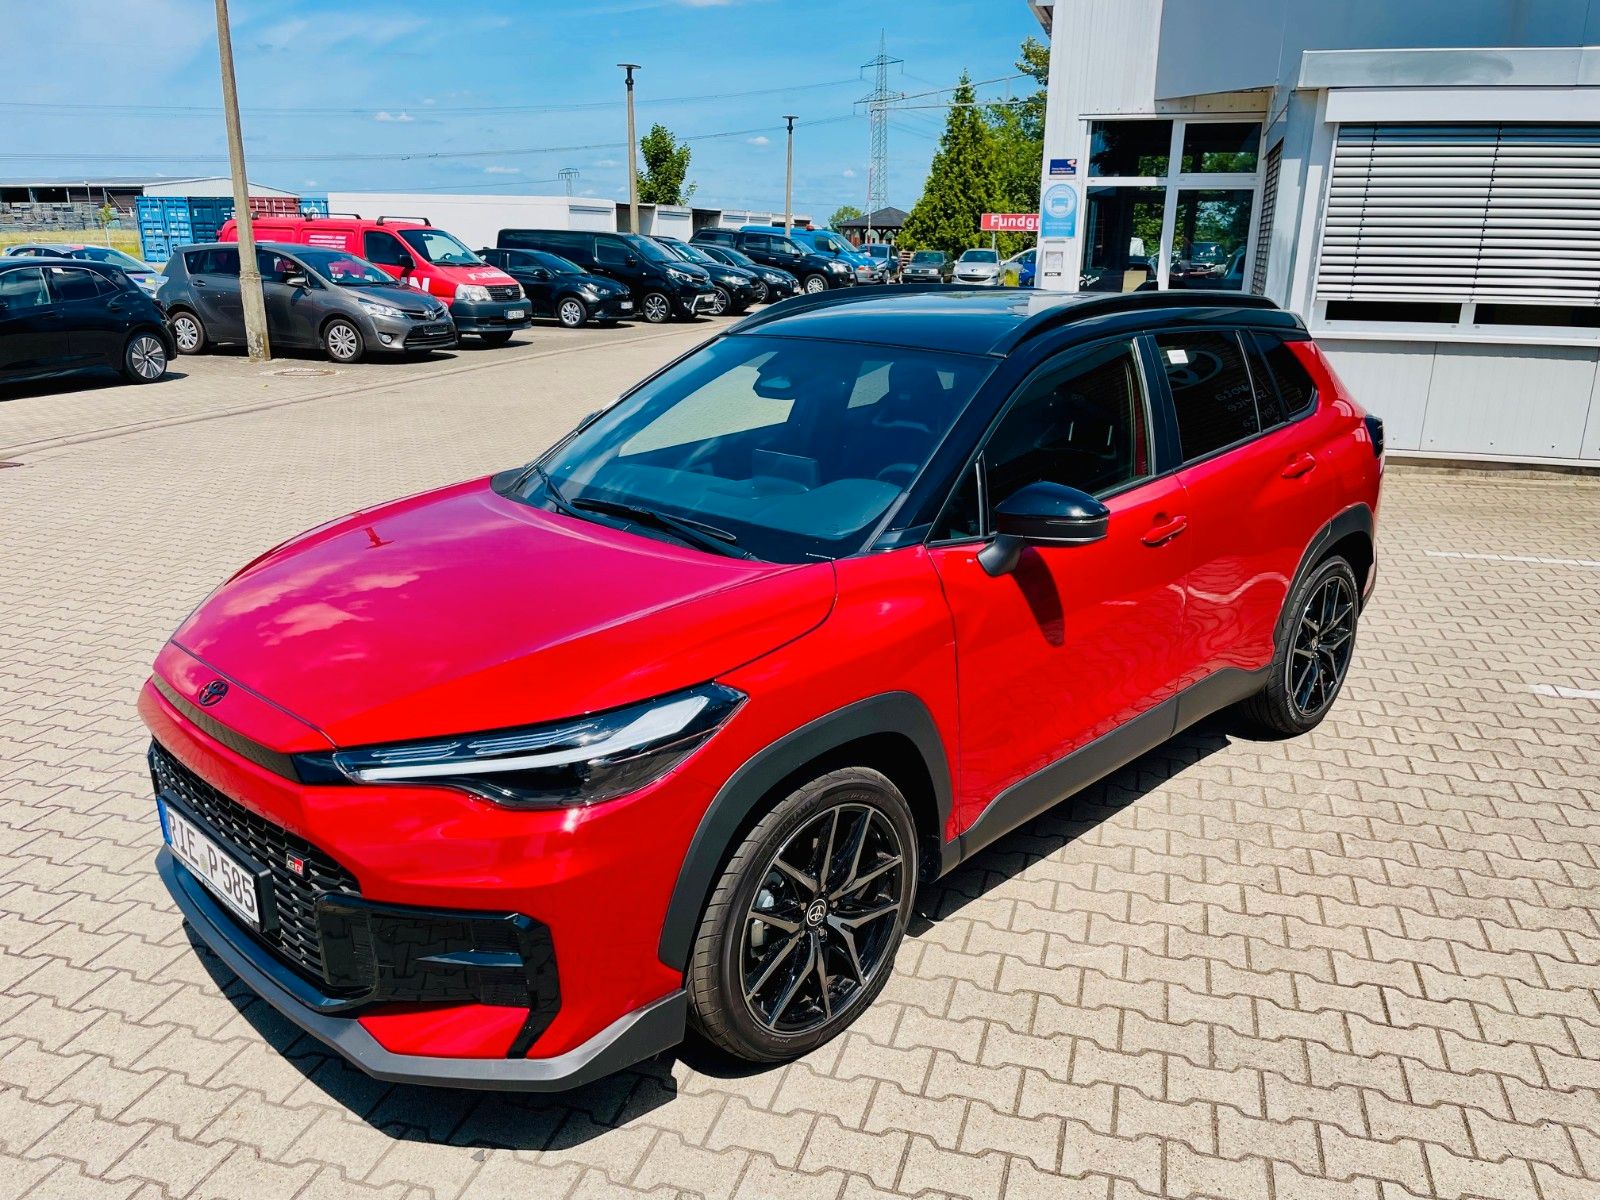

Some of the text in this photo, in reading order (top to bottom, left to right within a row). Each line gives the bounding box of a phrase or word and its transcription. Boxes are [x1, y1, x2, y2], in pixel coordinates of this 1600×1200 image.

[168, 812, 255, 913] RIE P 585
[287, 859, 303, 875] GR
